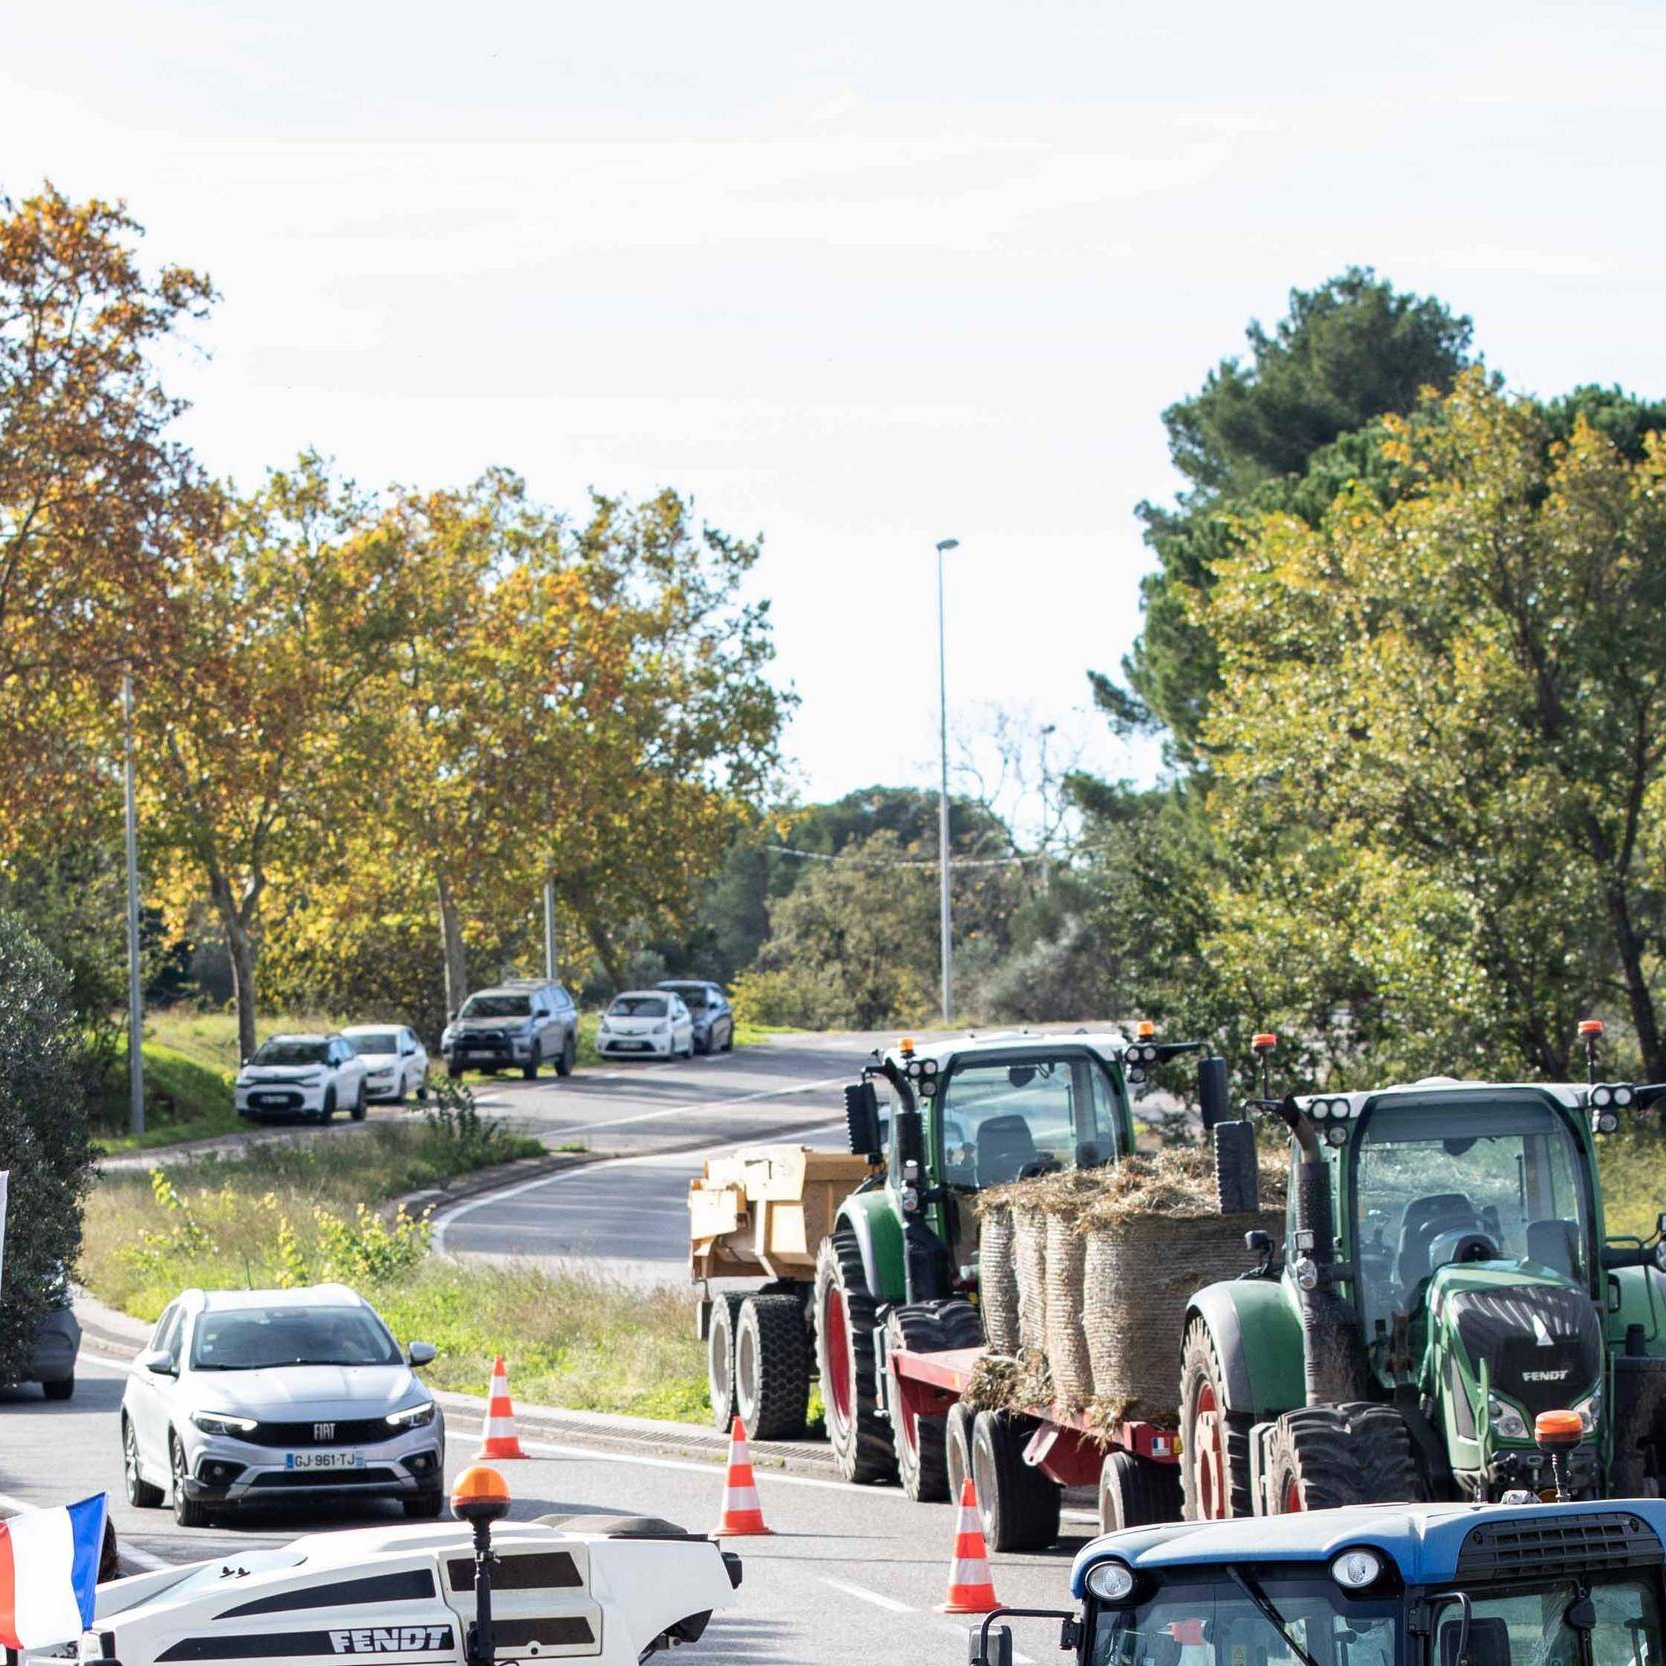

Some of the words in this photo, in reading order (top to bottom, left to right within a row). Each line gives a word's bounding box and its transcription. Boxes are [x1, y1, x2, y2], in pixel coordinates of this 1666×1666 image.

[1522, 1370, 1569, 1381] FENDT
[313, 1423, 336, 1441] FIAT
[329, 1626, 449, 1654] FENDT
